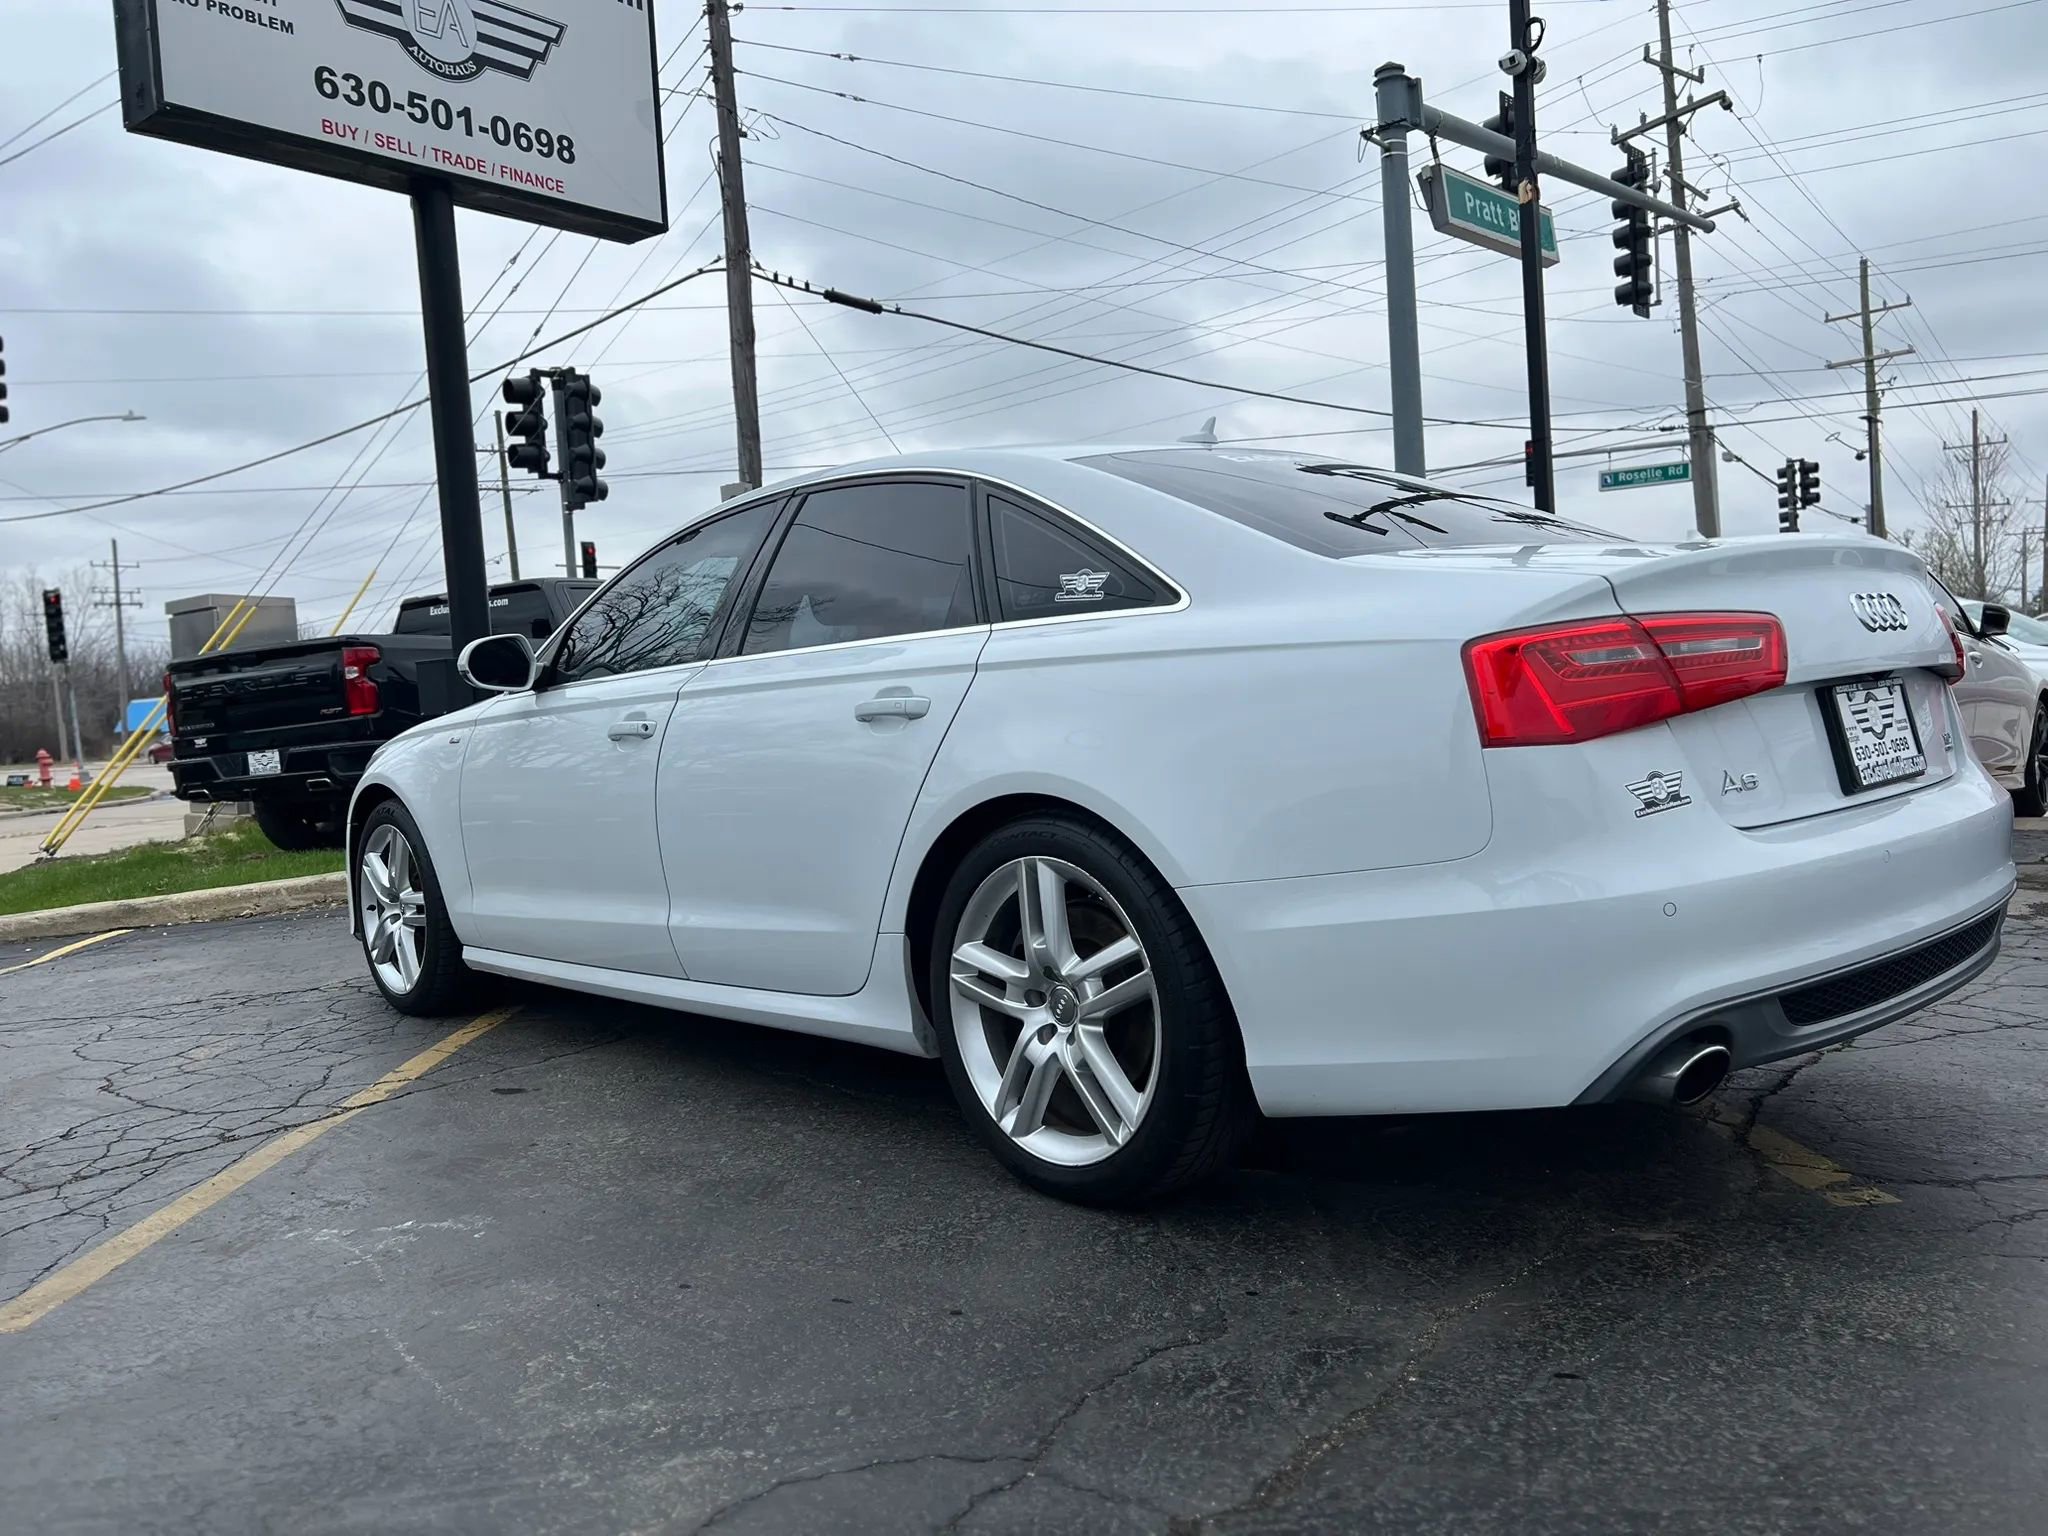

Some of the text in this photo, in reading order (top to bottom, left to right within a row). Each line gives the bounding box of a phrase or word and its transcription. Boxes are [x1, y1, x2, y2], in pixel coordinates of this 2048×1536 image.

[206, 0, 294, 35] PROBLEM
[407, 46, 477, 76] AUTOHAUS
[314, 65, 576, 165] 630-501-0698
[321, 118, 358, 141] BUY
[374, 132, 418, 158] SELL
[431, 147, 487, 174] TRADE
[500, 165, 565, 194] FINANCE
[1464, 191, 1505, 227] Pratt
[1618, 469, 1663, 482] Roselle
[1668, 465, 1684, 476] Rd
[1854, 736, 1911, 762] 630-501-0698
[1721, 769, 1760, 797] A6
